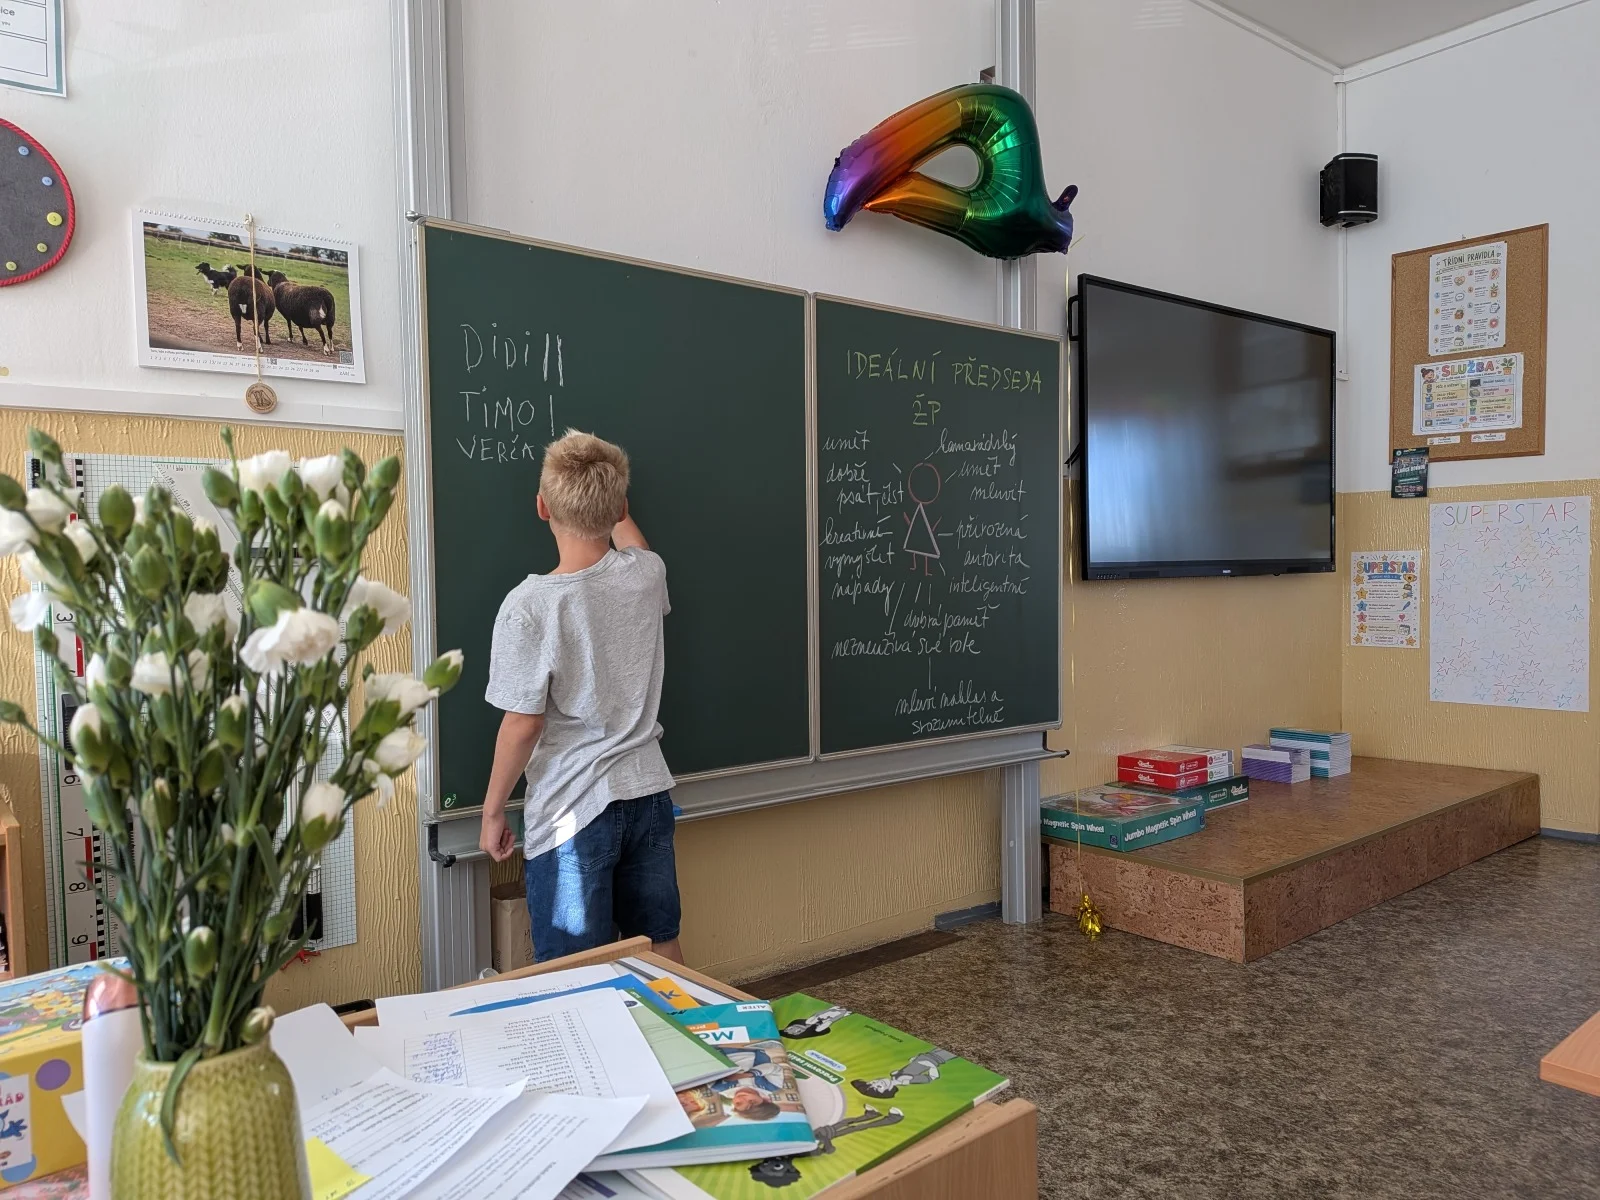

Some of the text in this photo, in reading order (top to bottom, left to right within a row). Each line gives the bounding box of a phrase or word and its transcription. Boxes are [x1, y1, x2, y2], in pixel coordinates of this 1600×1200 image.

[1467, 250, 1495, 262] PRAVIDLA
[847, 347, 1042, 393] IDEÁLNÍ PŘEDSEDA
[1441, 360, 1495, 378] SLUŽBA
[1442, 501, 1578, 527] SUPERSTAR
[1356, 560, 1416, 574] SUPERSTAR
[1043, 818, 1070, 830] Magnetic
[1070, 821, 1086, 832] Spin
[1086, 823, 1105, 833] Wheel
[1124, 808, 1197, 842] Jumbo Magnetic Spin Wheel
